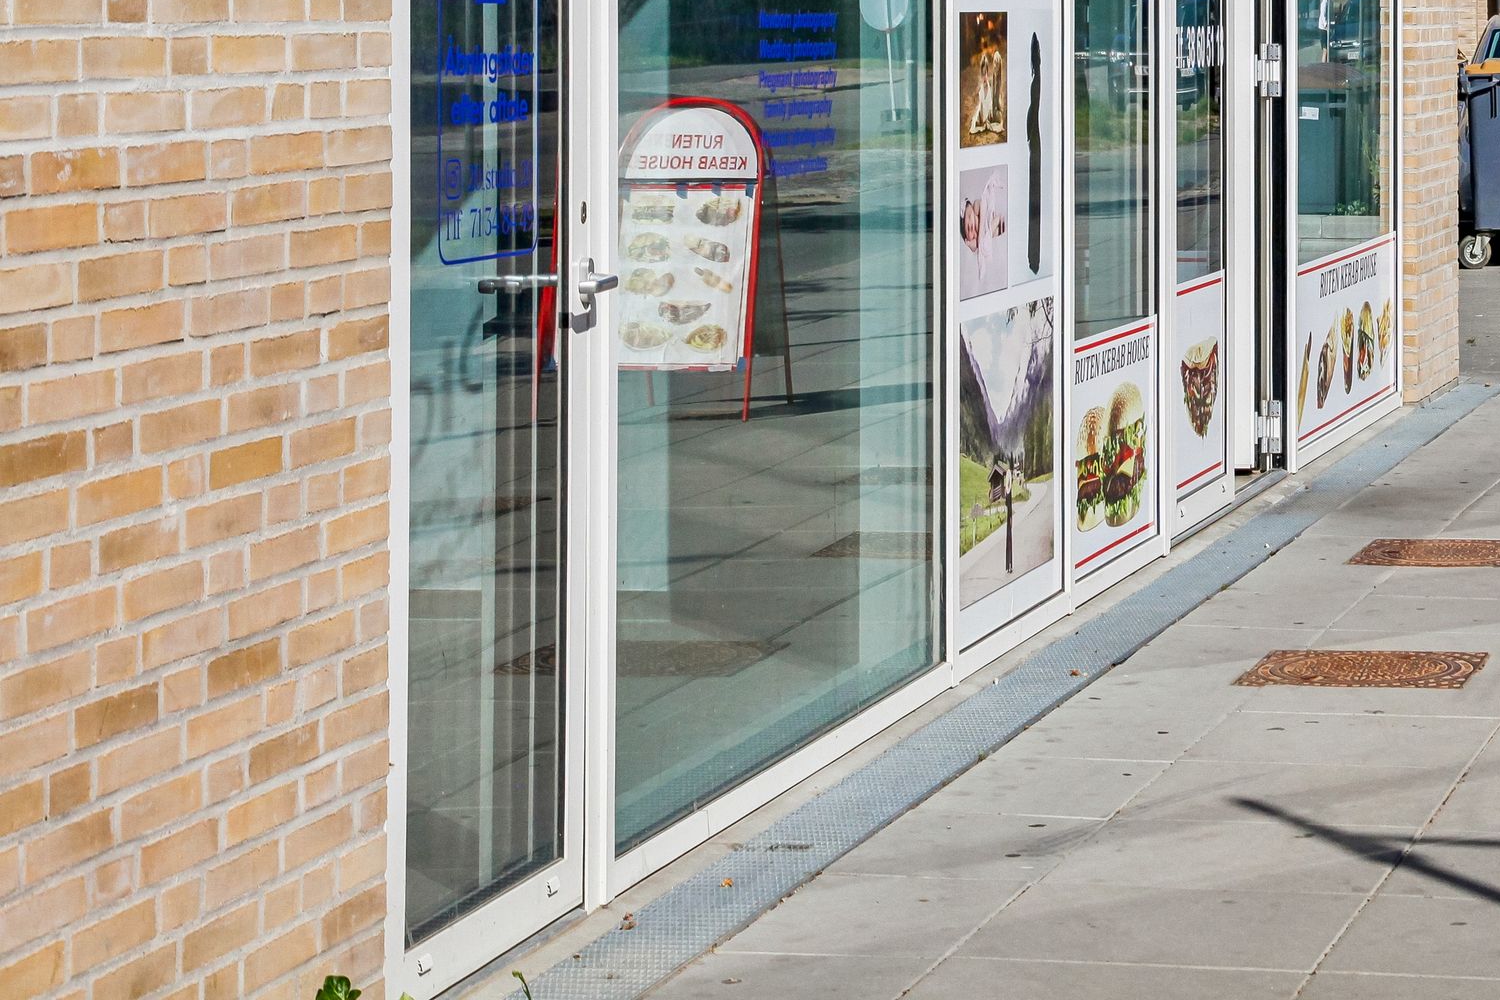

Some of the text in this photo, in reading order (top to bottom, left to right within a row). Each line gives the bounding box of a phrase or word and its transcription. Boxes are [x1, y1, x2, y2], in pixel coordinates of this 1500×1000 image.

[445, 35, 534, 83] Åbningstider
[1320, 253, 1377, 298] RUTEN KEBAB HOUSE
[1074, 335, 1150, 385] RUTEN KEBAB HOUSE
